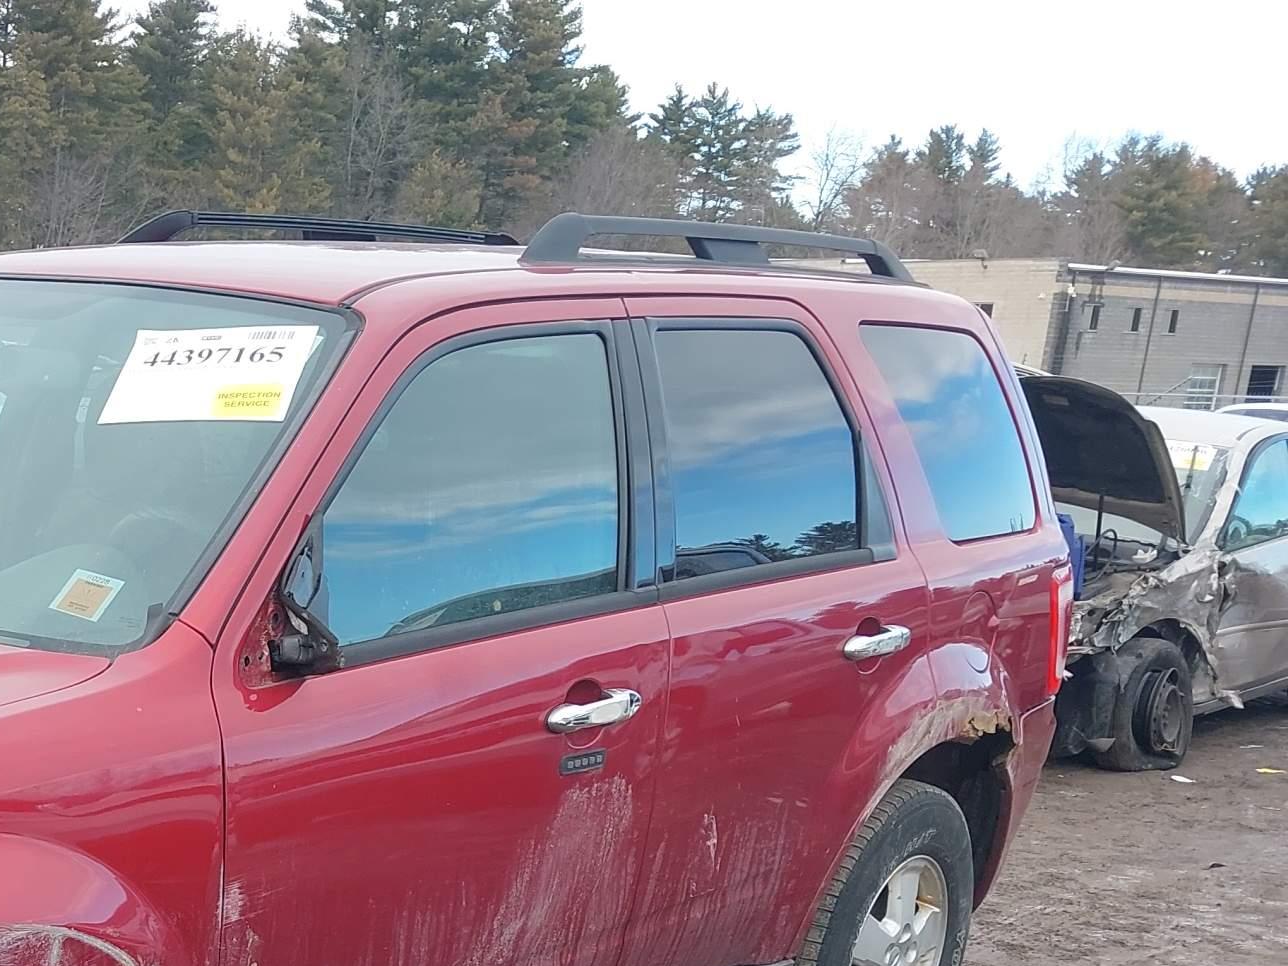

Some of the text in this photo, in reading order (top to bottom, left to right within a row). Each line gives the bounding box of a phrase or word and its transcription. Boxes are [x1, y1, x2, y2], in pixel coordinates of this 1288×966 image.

[143, 346, 287, 367] 44397165
[217, 391, 282, 399] INSPECTION
[223, 400, 270, 408] SERVICE
